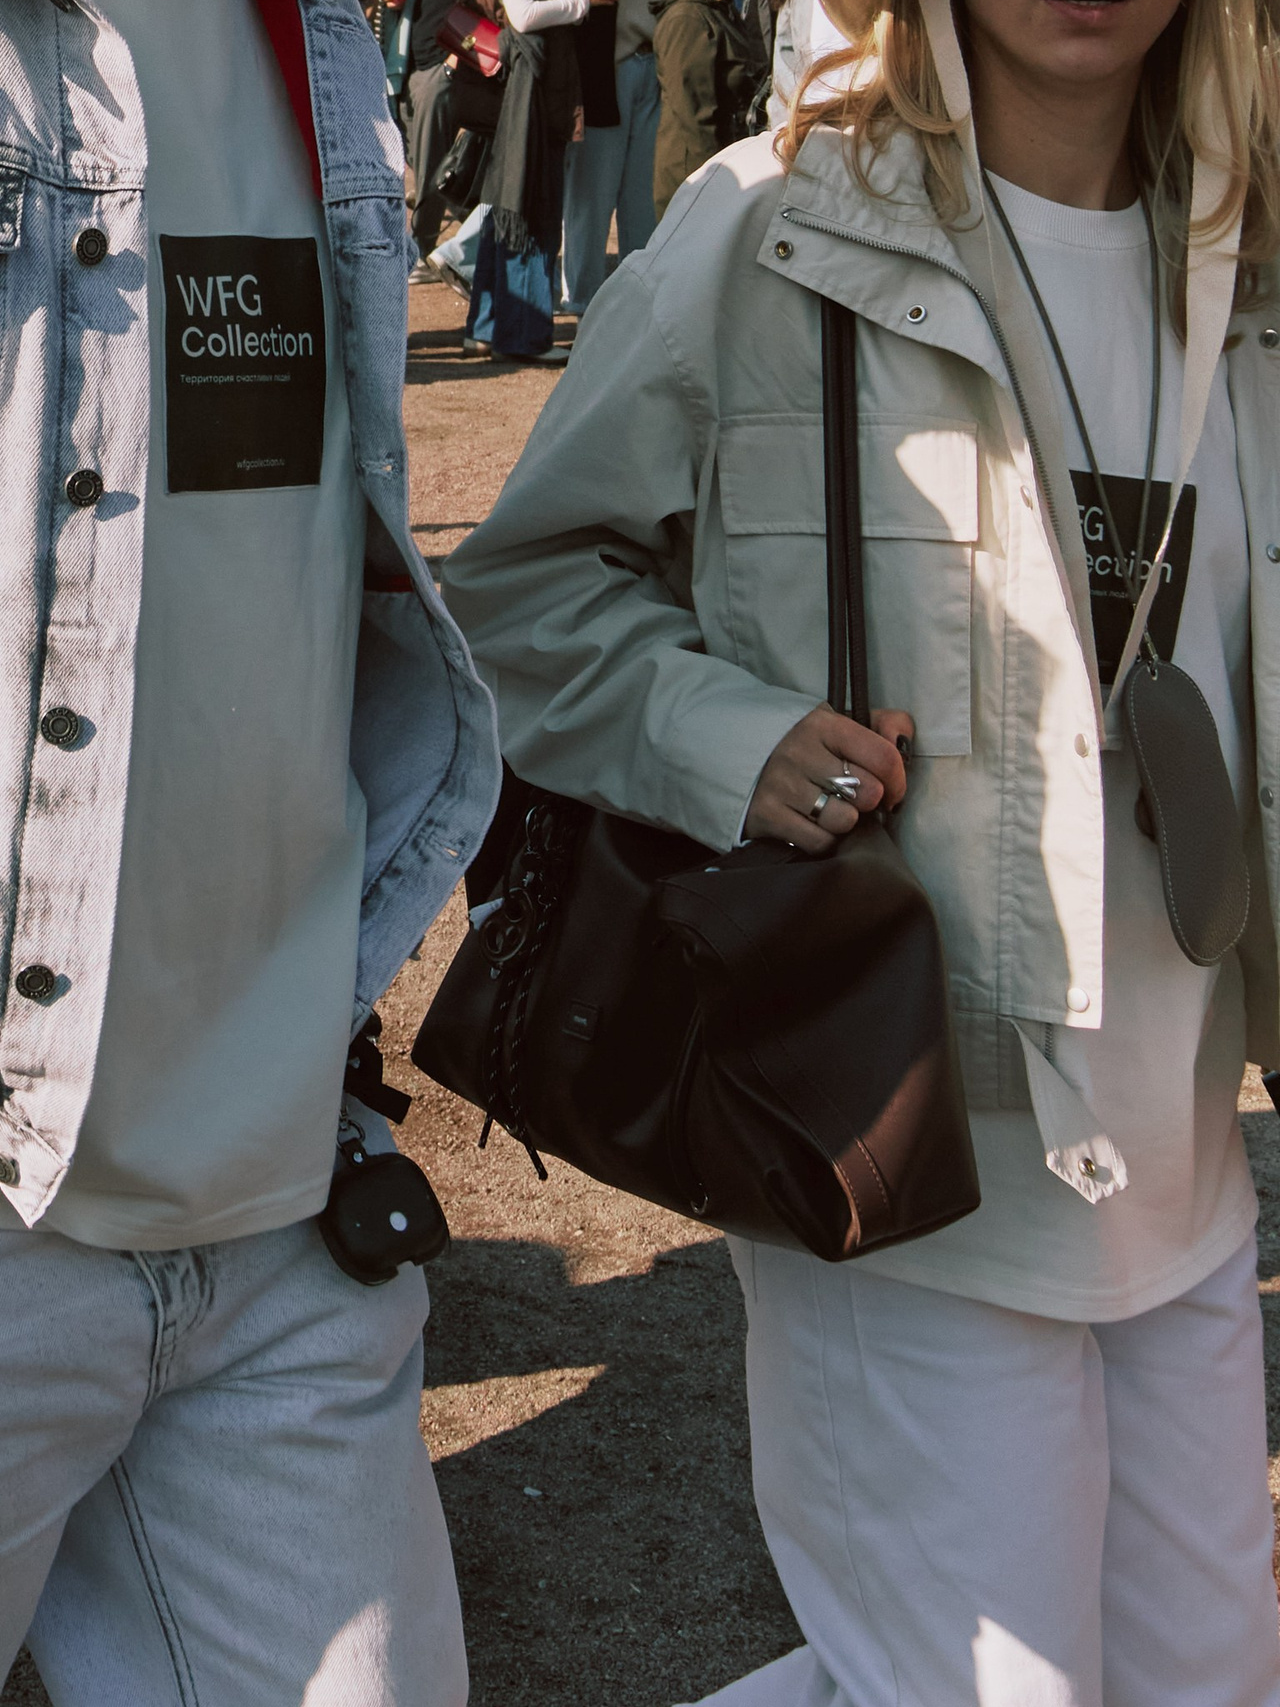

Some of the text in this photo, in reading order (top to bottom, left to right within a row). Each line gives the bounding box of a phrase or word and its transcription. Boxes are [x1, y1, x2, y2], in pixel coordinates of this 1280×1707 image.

[176, 274, 262, 318] WFG
[181, 323, 314, 358] Collection
[179, 373, 235, 385] Территория
